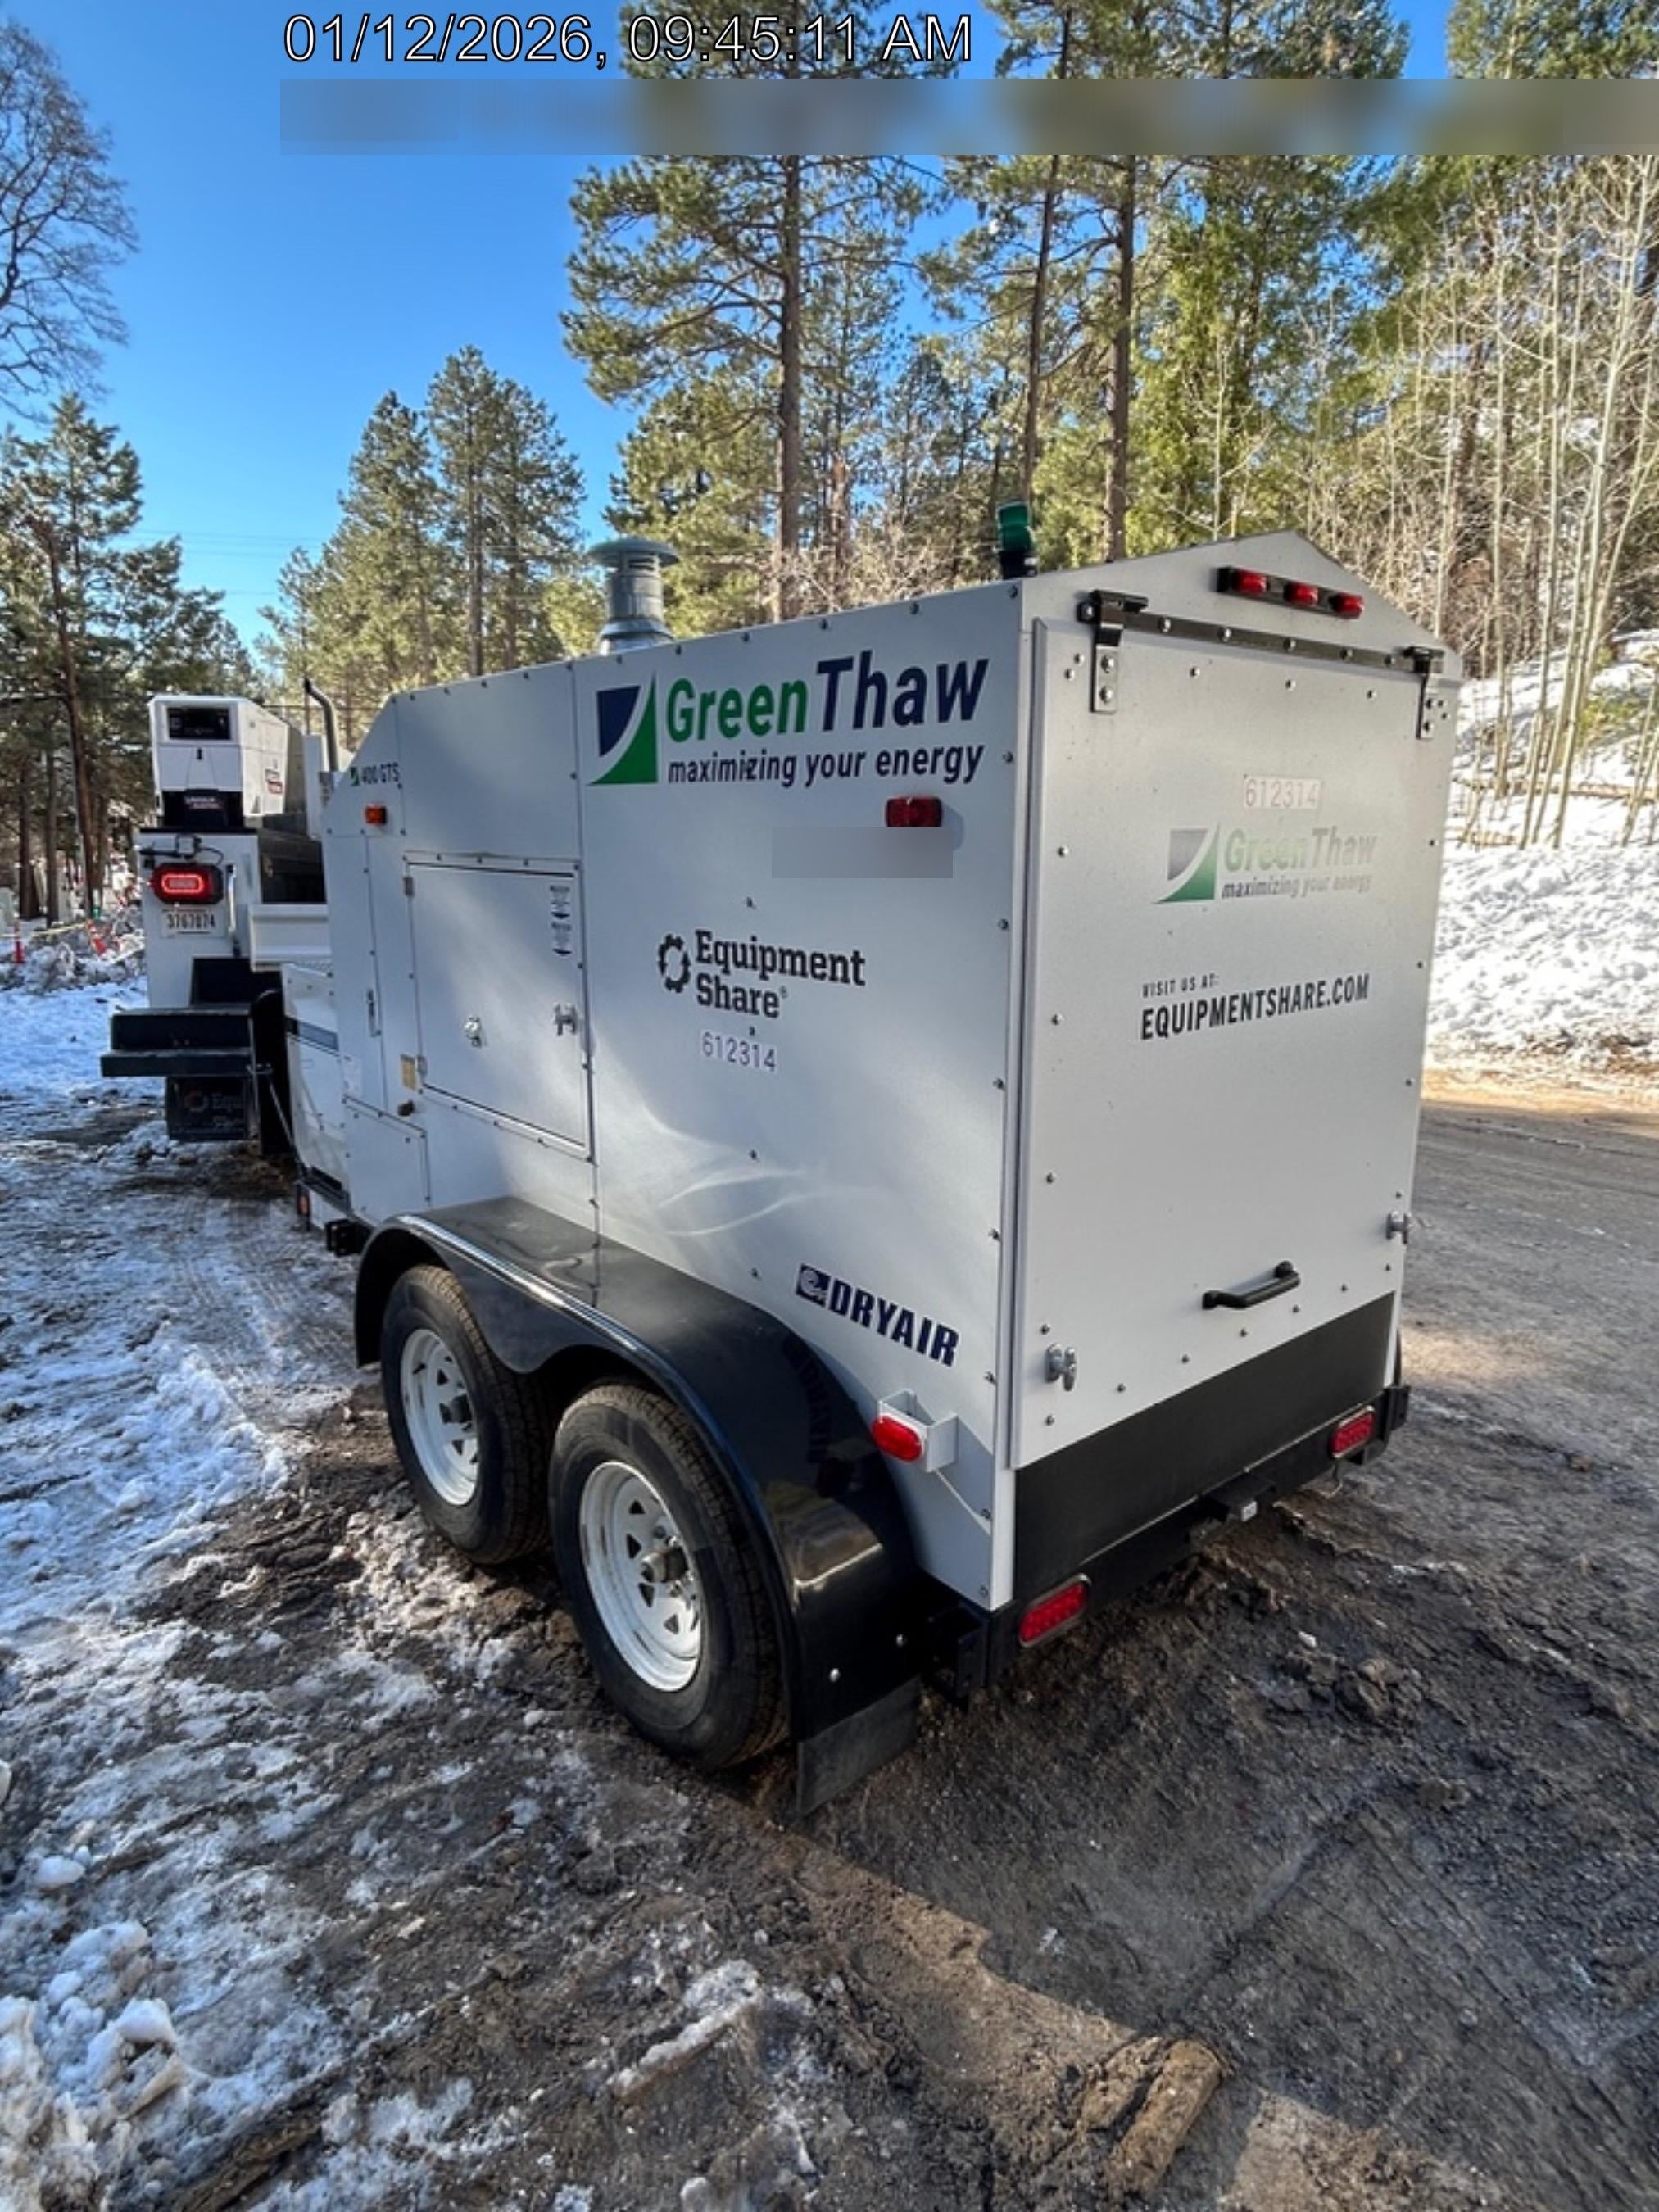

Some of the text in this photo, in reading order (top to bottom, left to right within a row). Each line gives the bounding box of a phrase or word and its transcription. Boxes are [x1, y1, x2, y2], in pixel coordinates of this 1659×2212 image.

[668, 745, 985, 788] maximizing your energy
[1245, 778, 1317, 808] 612314
[1222, 875, 1374, 900] maximizing your energy
[696, 929, 866, 986] Equipment
[1141, 973, 1370, 1040] EQUIPMENTSHARE.COM
[1143, 979, 1176, 998] VISIT
[1181, 976, 1195, 992] US
[702, 1031, 777, 1072] 612314
[827, 1277, 959, 1367] DRYAIR
